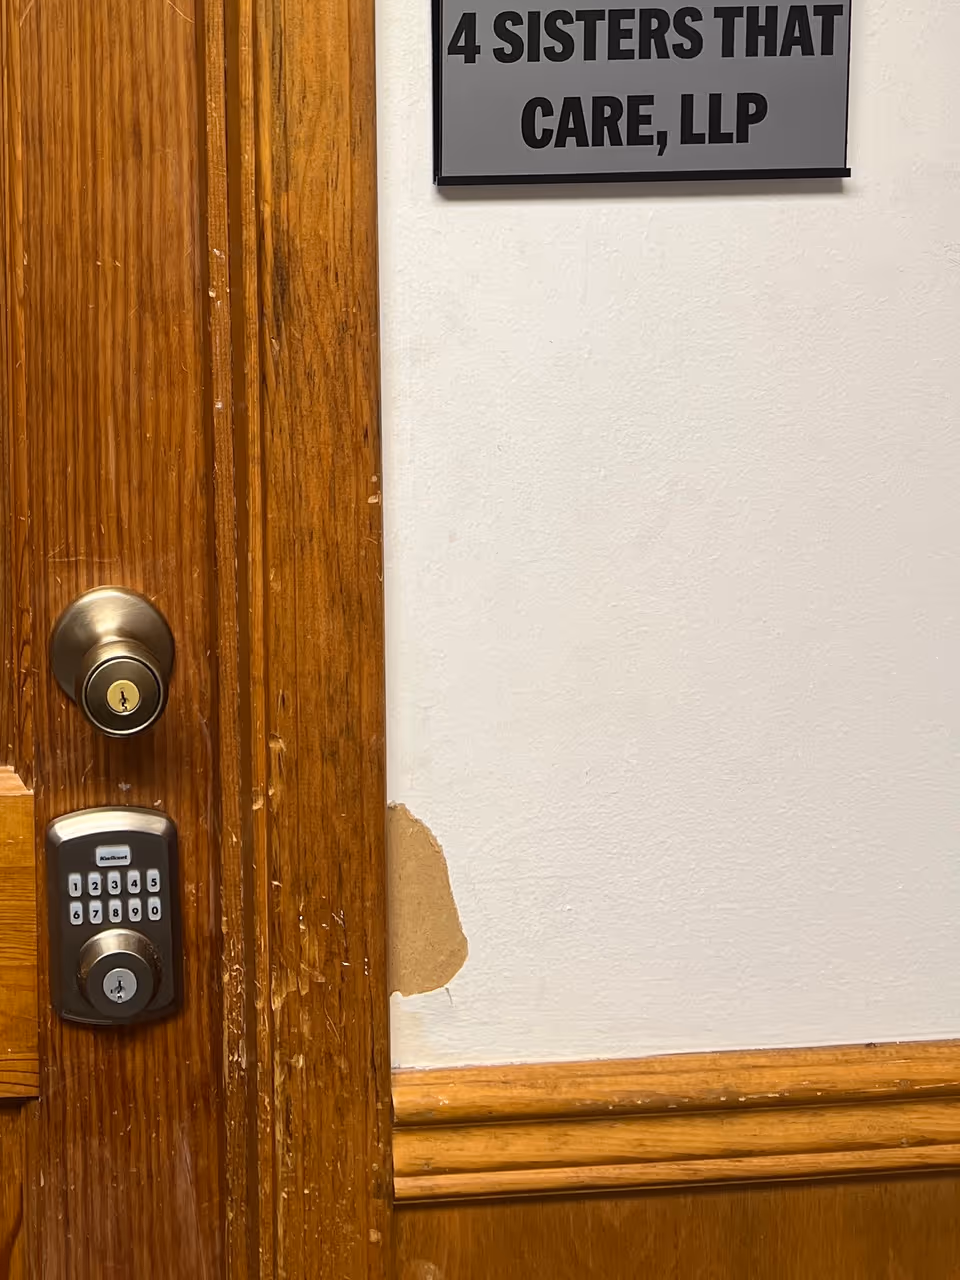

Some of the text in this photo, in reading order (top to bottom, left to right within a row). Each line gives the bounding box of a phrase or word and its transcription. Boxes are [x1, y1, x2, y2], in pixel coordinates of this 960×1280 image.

[447, 4, 844, 64] 4 SISTERS THAT
[520, 92, 769, 157] CARE, LLP
[73, 878, 158, 892] 1 2 3 4 5
[72, 906, 159, 920] 6 7 8 9 0
